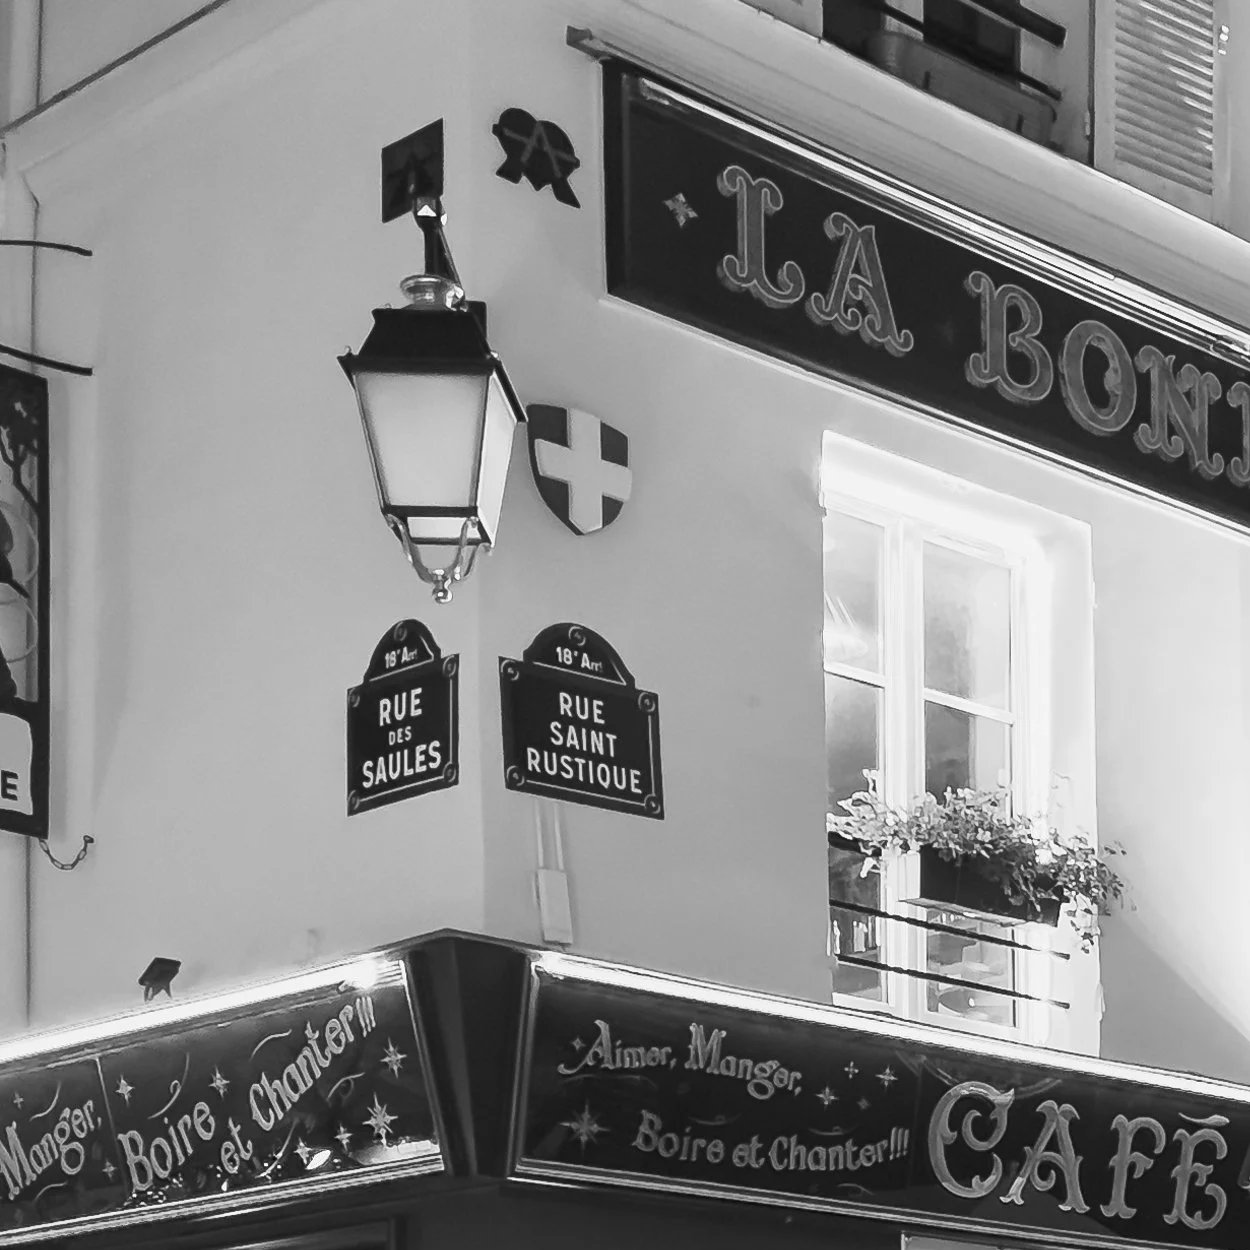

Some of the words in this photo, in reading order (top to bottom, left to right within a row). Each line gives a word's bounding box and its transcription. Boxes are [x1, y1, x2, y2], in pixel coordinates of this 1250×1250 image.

[717, 166, 913, 356] LA
[379, 687, 422, 727] RUE
[559, 692, 605, 724] RUE
[389, 726, 412, 746] DES
[550, 721, 617, 757] SAINT
[362, 740, 441, 788] SAULES
[527, 747, 642, 794] RUSTIQUE
[557, 1020, 678, 1075] Aimer,
[684, 1022, 802, 1099] Manger,
[118, 1100, 216, 1191] Boire
[220, 1117, 253, 1174] et
[634, 1109, 724, 1166] Boire
[731, 1137, 764, 1169] et
[769, 1127, 910, 1173] Chanter!!!
[928, 1079, 1229, 1230] CAFÉ
